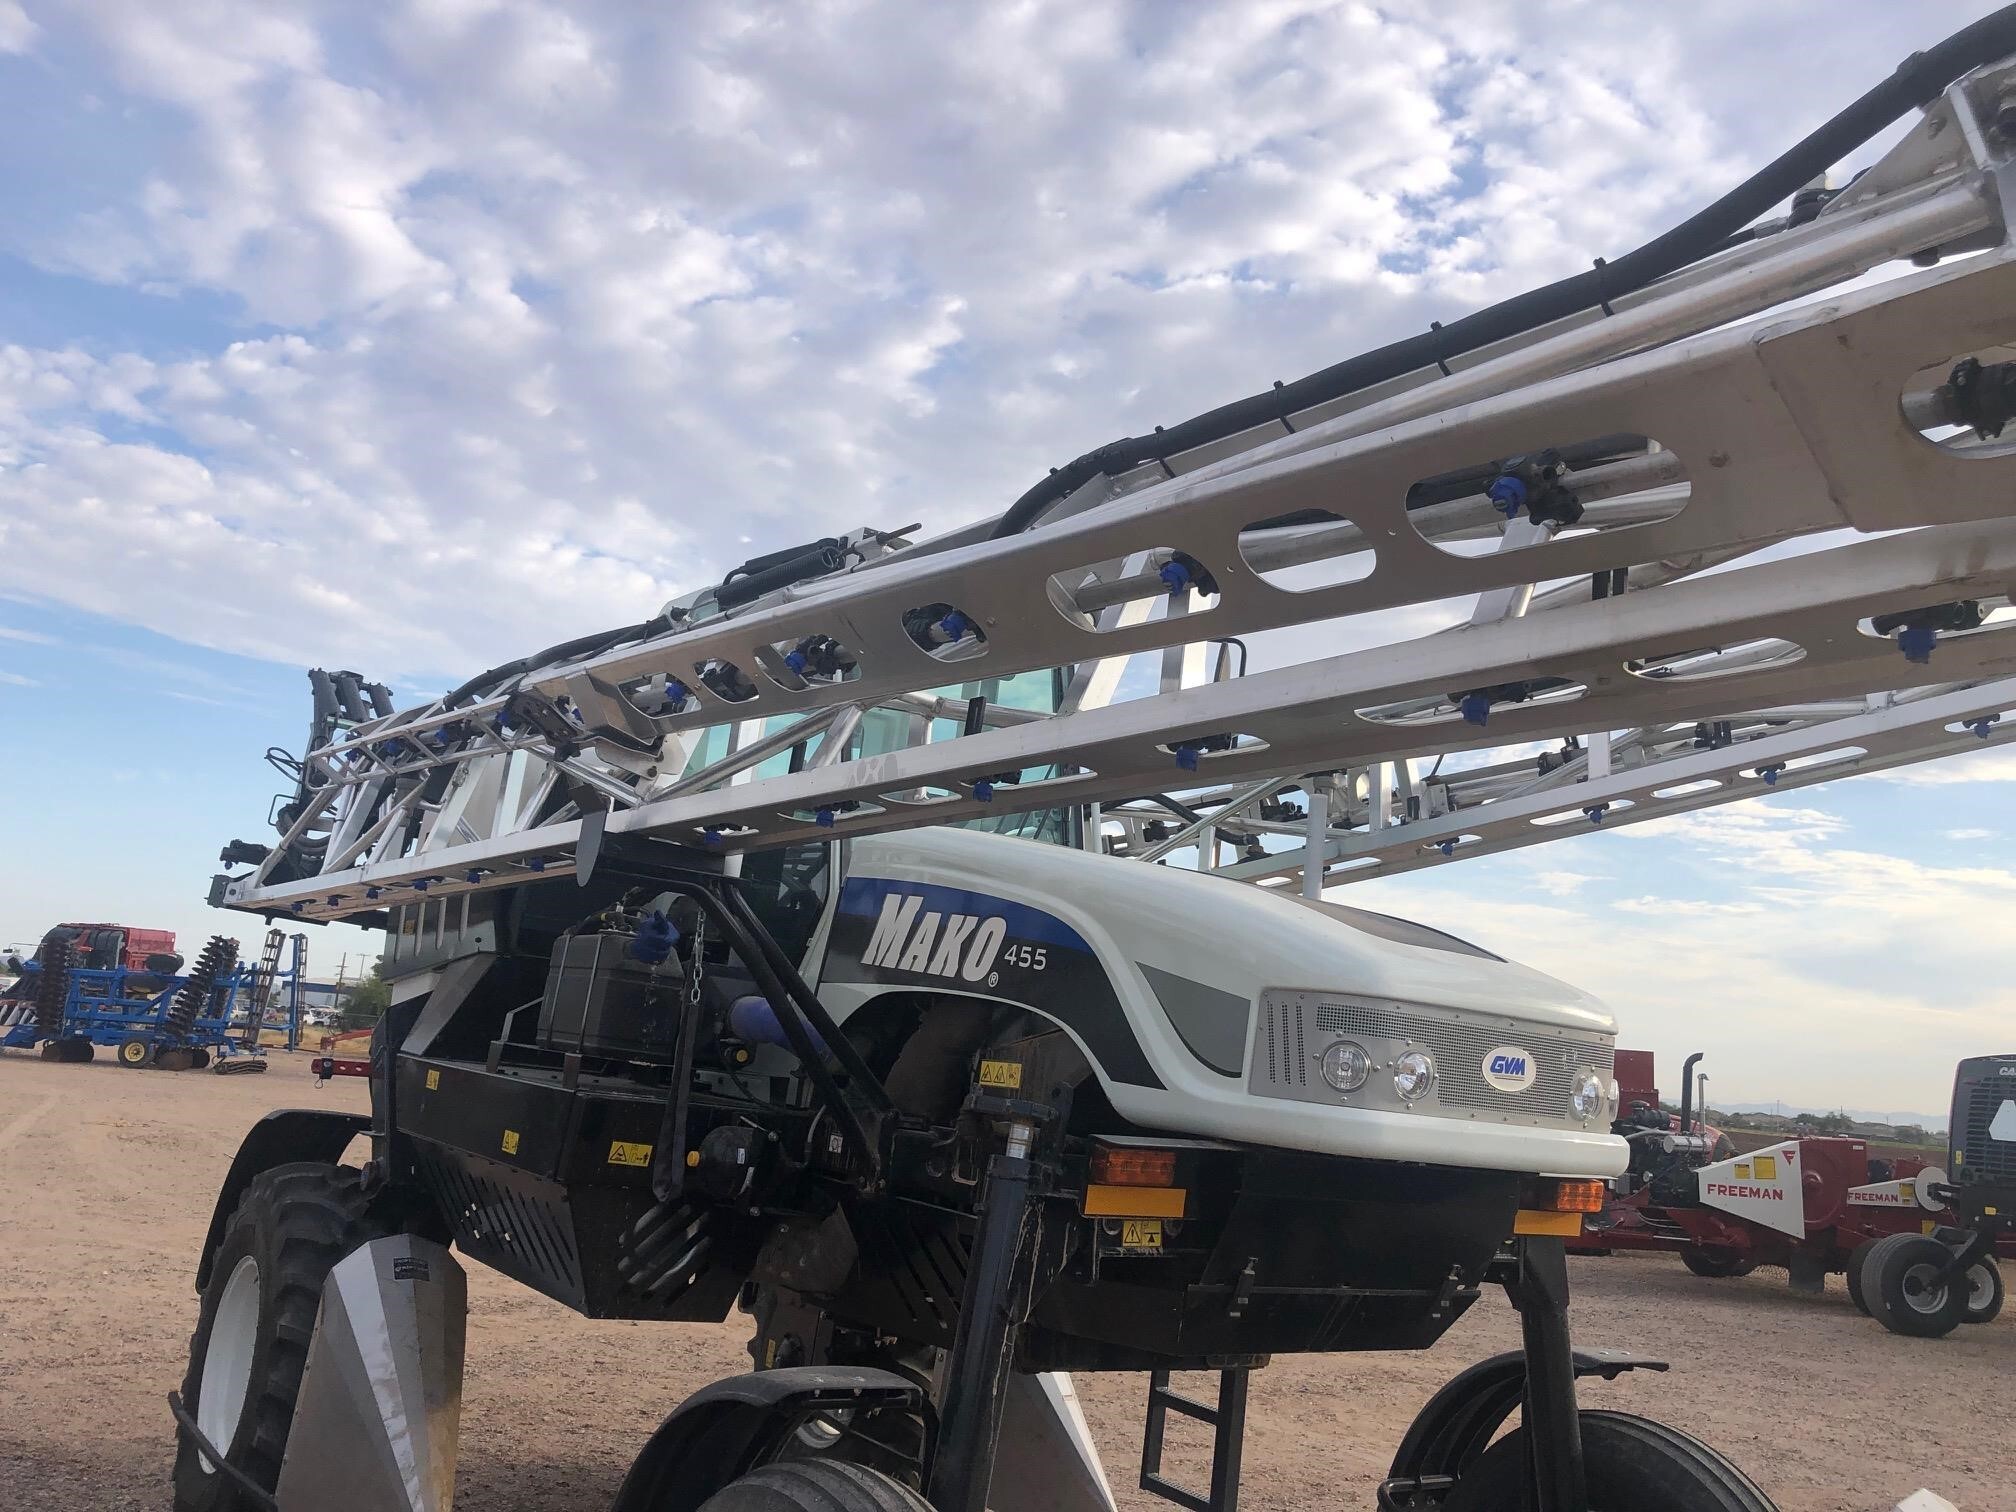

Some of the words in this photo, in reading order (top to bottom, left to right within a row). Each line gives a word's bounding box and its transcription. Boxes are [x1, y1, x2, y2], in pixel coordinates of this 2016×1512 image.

[1004, 944, 1047, 970] 455
[1490, 1055, 1526, 1076] GVM
[1707, 1183, 1784, 1200] FREEMAN
[1848, 1193, 1899, 1203] FREEMAN
